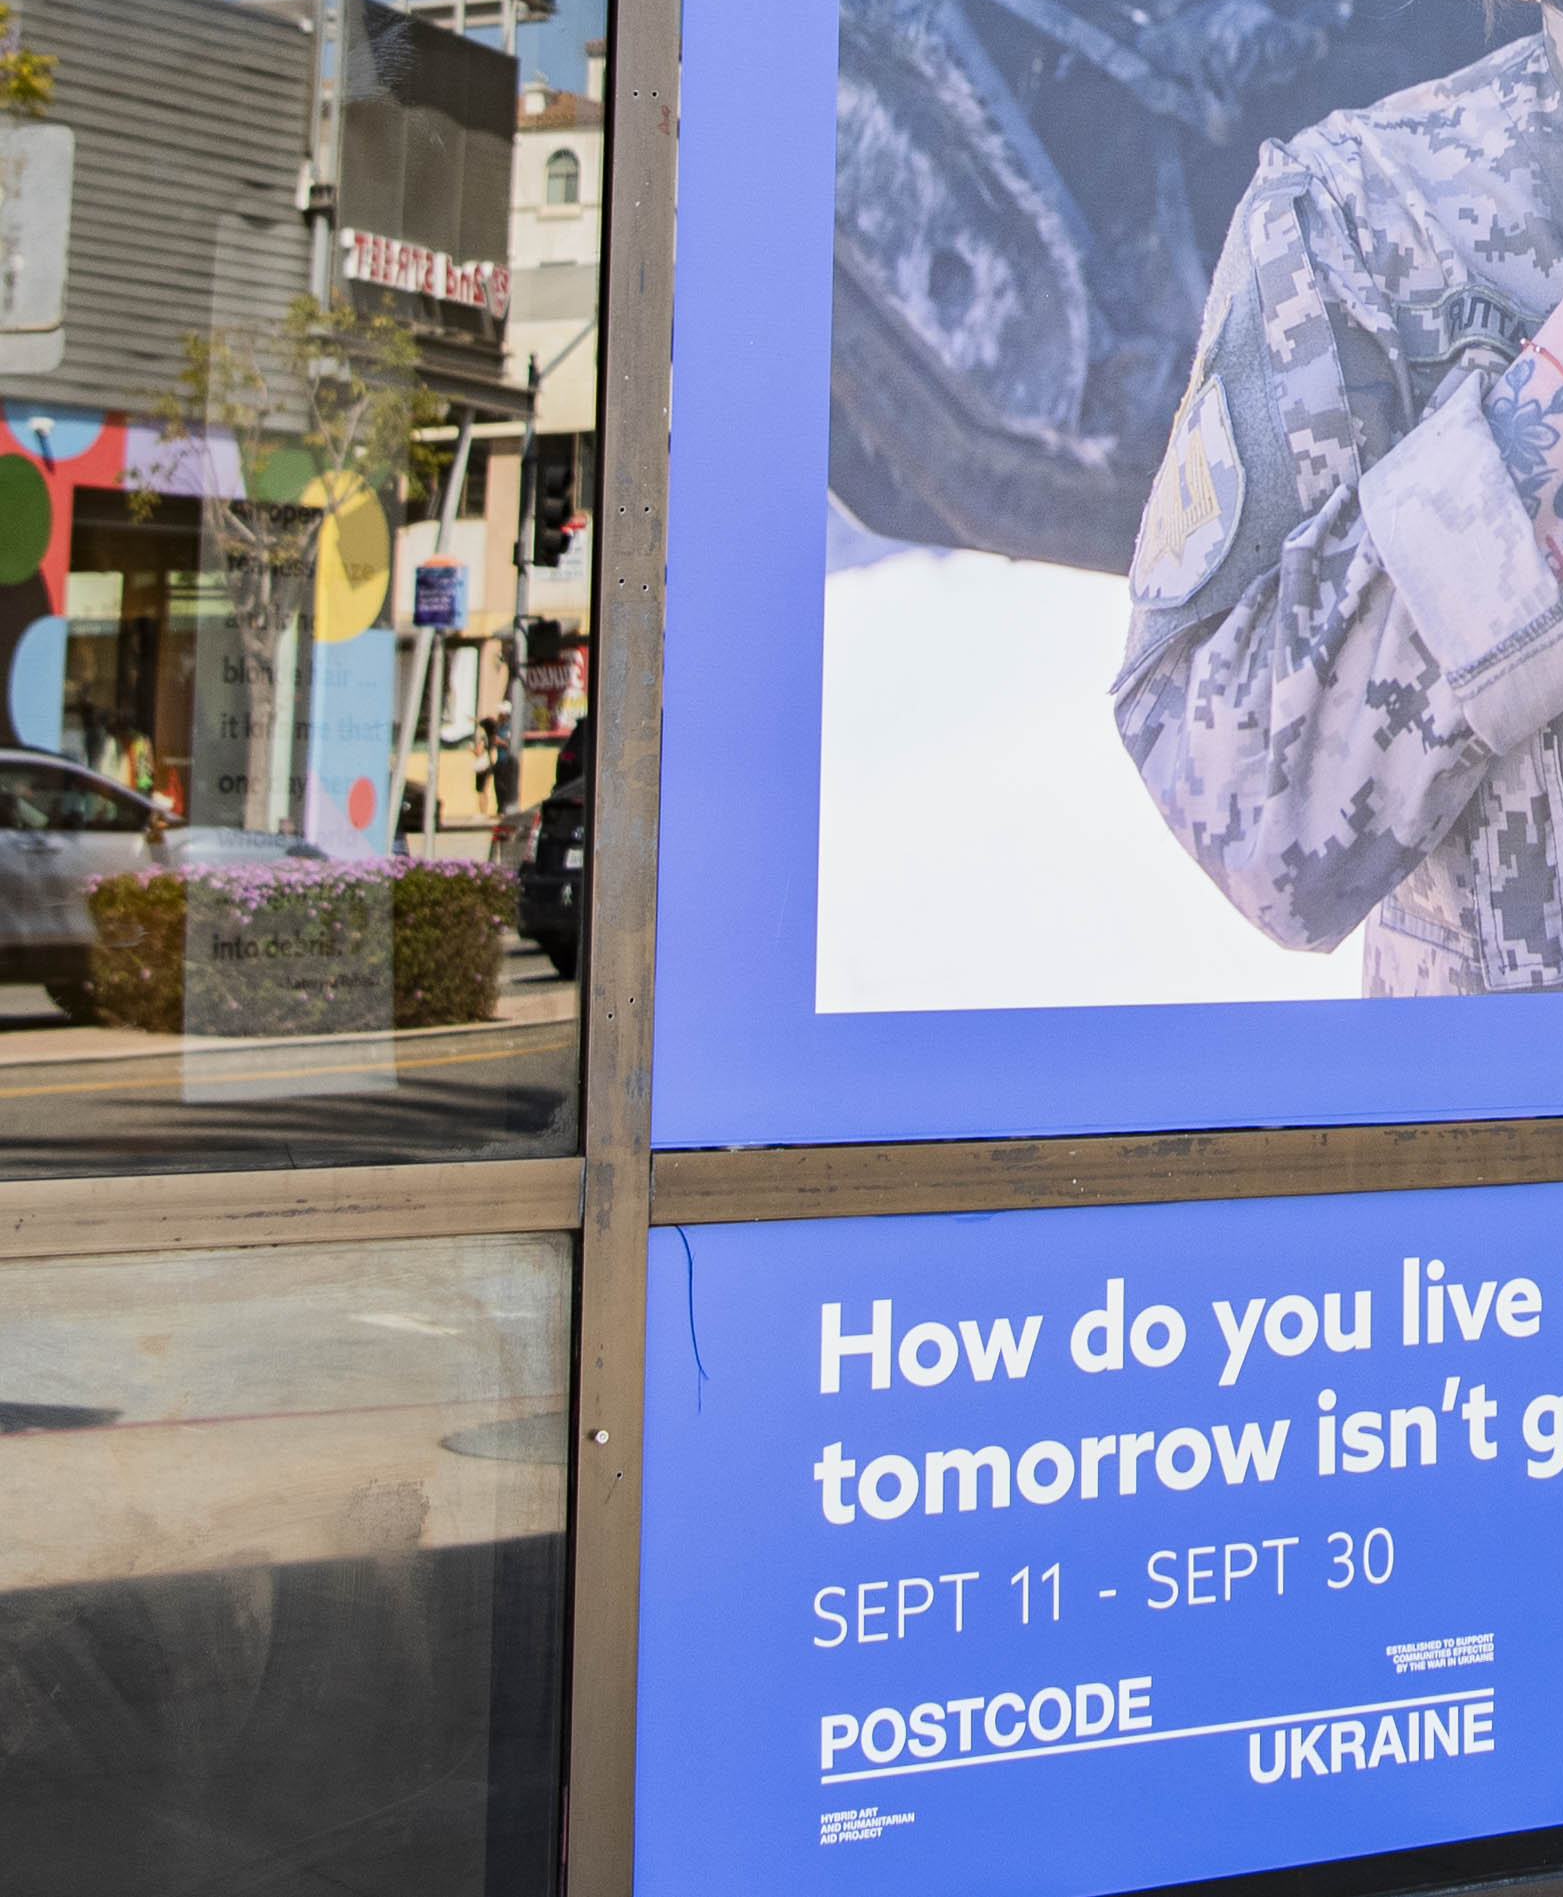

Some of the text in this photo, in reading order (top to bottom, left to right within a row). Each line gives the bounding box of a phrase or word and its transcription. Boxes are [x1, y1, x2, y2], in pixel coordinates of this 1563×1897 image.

[821, 1299, 1043, 1394] How
[1071, 1278, 1186, 1372] do
[1211, 1291, 1372, 1387] you
[1403, 1256, 1542, 1345] live
[814, 1420, 1290, 1524] tomorrow
[813, 1572, 980, 1648] SEPT
[1010, 1563, 1060, 1625] 11
[1147, 1538, 1299, 1610] SEPT
[1327, 1528, 1394, 1589] 30
[1386, 1633, 1494, 1656] ESTABLISHED TO SUPPORT
[1393, 1649, 1451, 1664] COMMUNITIES
[1396, 1651, 1494, 1674] BY THE WAR IN UKRAINE
[821, 1677, 1153, 1770] POSTCODE
[1249, 1701, 1494, 1784] UKRAINE
[820, 1806, 879, 1824] HYBRID ART
[820, 1811, 915, 1835] AND HUMANITARIAN
[820, 1826, 883, 1845] AID PROJECT
